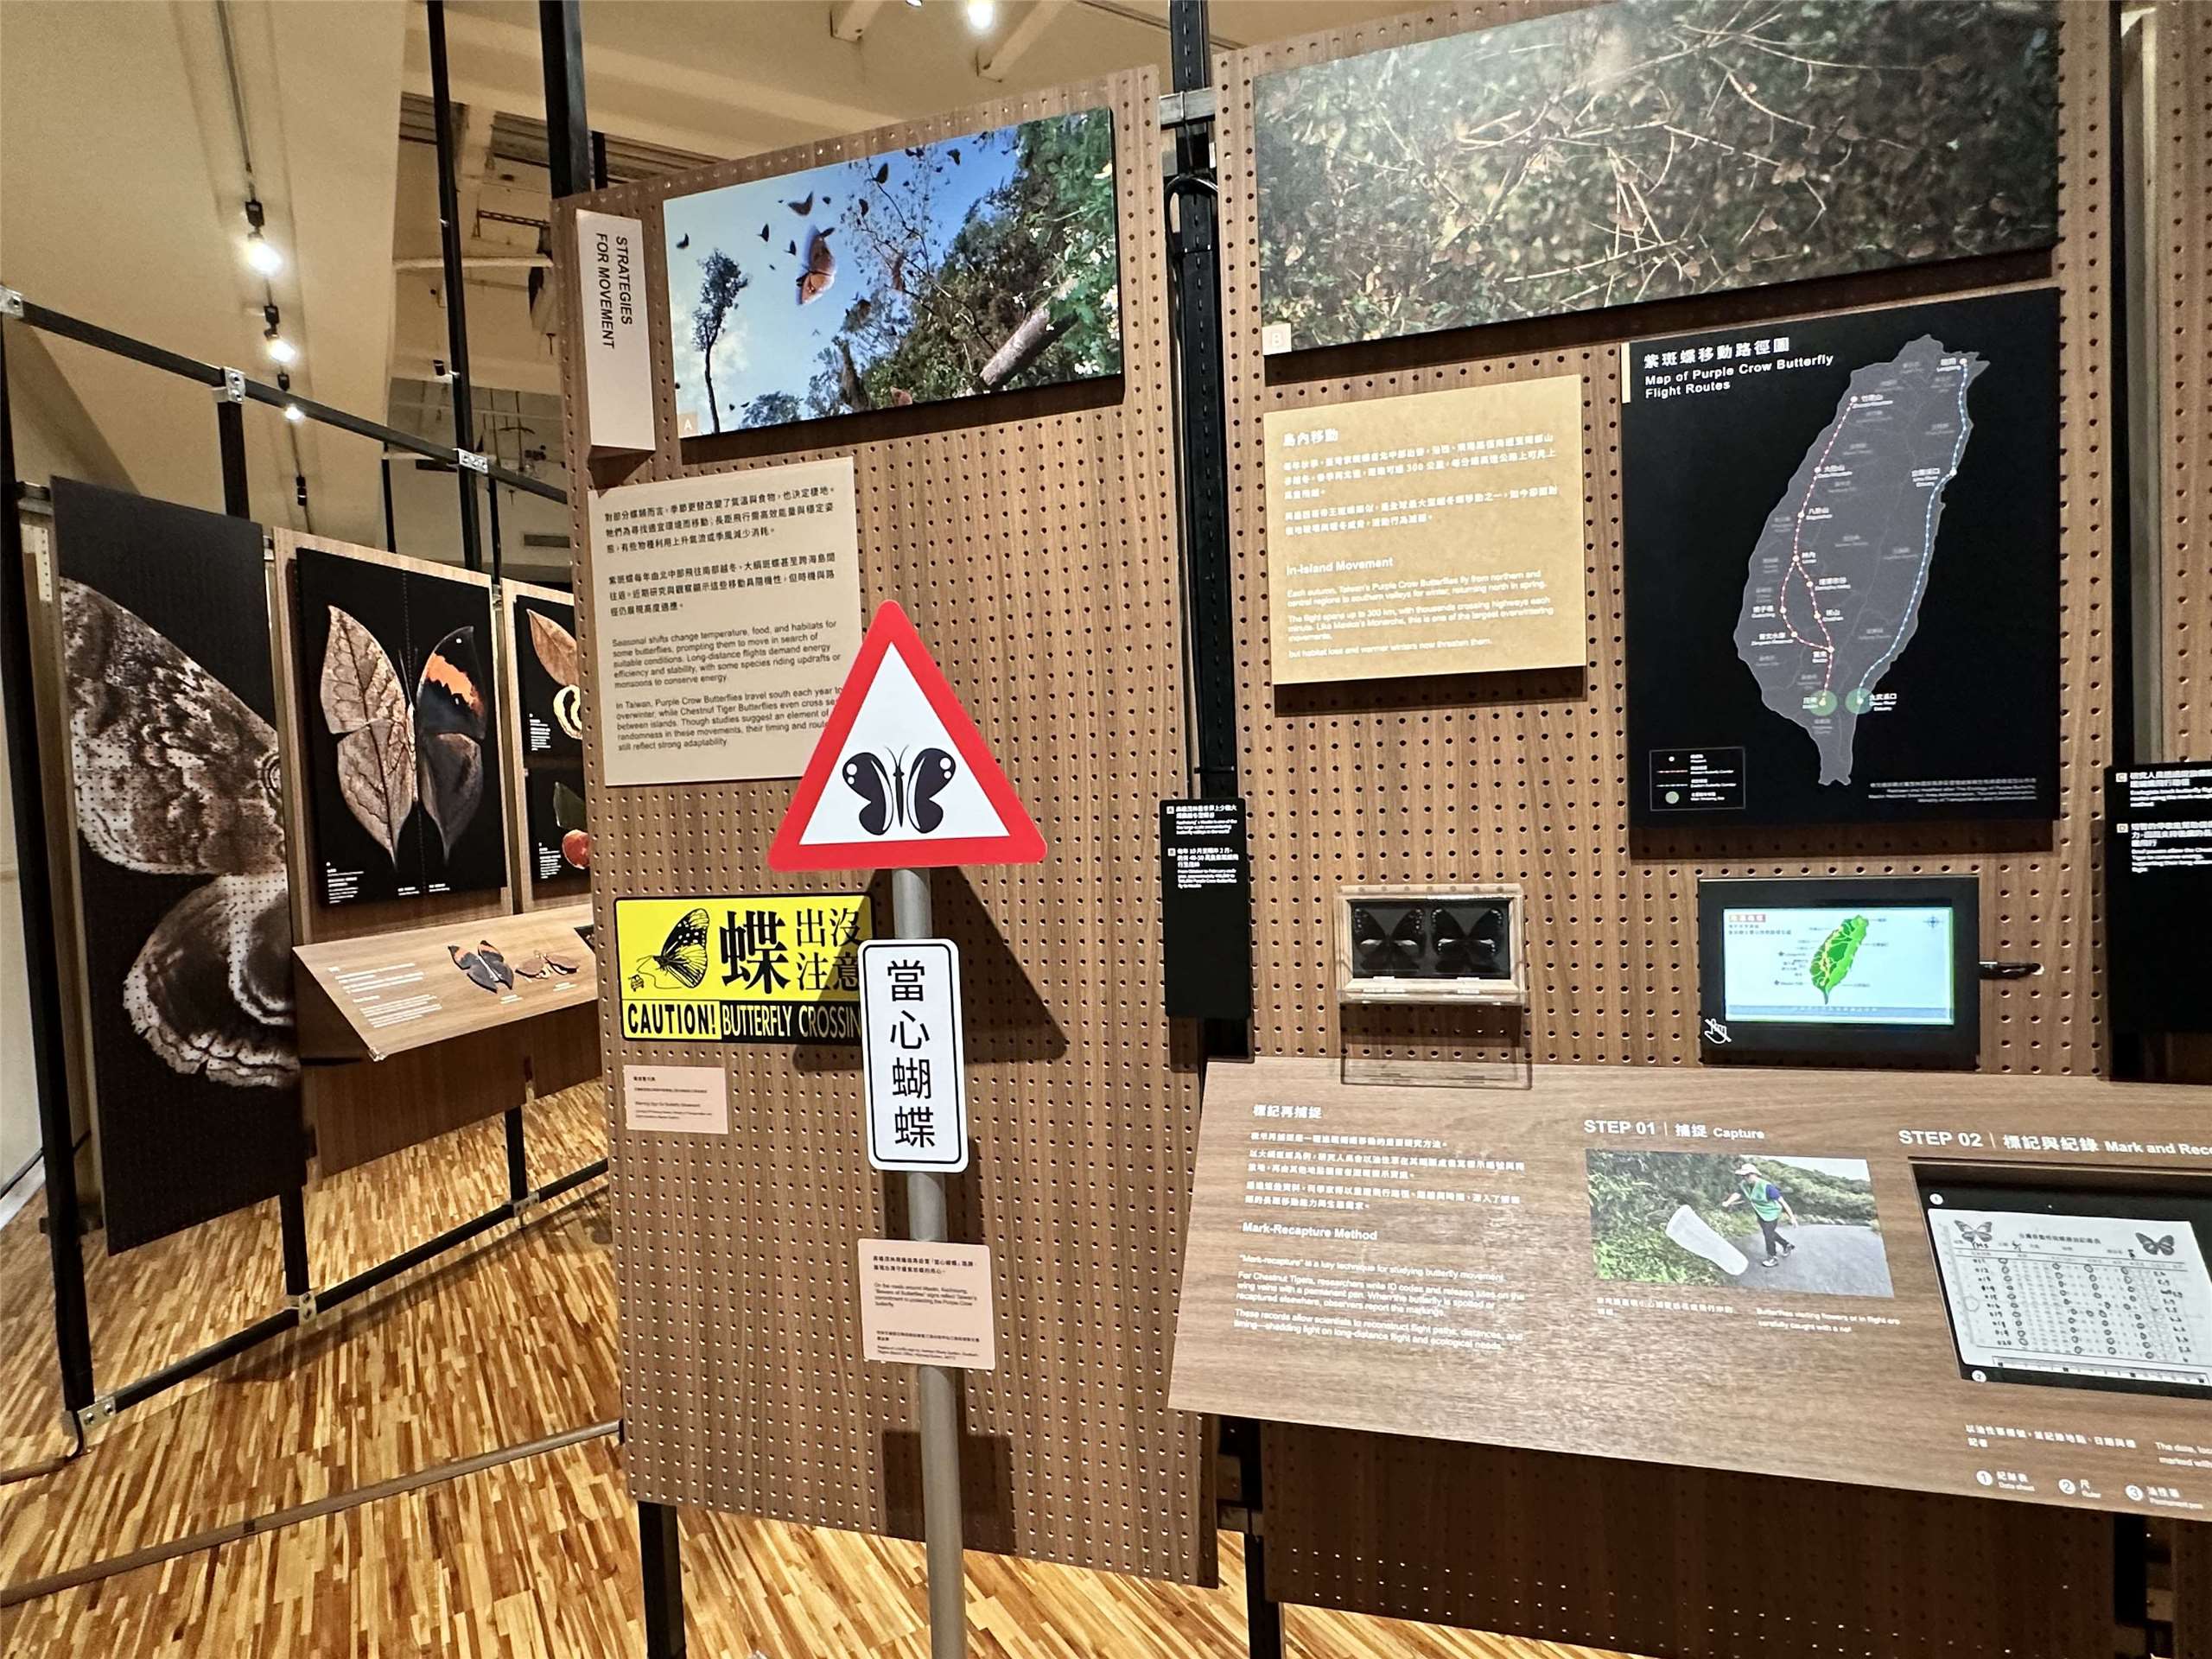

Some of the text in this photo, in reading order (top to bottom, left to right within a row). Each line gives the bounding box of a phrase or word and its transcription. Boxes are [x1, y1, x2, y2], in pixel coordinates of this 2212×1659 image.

[596, 232, 615, 349] FOR MOVEMENT
[615, 235, 632, 325] STRATEGIES
[1643, 337, 1790, 369] 紫斑蝶移動路徑圖
[1645, 354, 1834, 387] Map of Purple Crow Butterfly
[1645, 380, 1731, 399] Flight Routes
[671, 632, 698, 641] change
[774, 624, 789, 632] and
[791, 622, 823, 631] habitats
[676, 641, 715, 653] prompting
[780, 633, 808, 643] search
[686, 651, 741, 662] Long-distance
[742, 648, 766, 658] flights
[768, 645, 800, 655] demand
[803, 645, 830, 653] energy
[613, 668, 648, 677] efficiency
[651, 665, 665, 674] and
[699, 662, 715, 671] with
[741, 658, 771, 670] species
[772, 657, 795, 666] riding
[797, 654, 830, 665] updrafts
[655, 697, 679, 707] Purple
[703, 693, 742, 702] Butterflies
[744, 691, 766, 700] travel
[768, 690, 791, 698] south
[792, 688, 812, 696] each
[815, 689, 832, 697] year
[658, 707, 677, 715] while
[680, 705, 715, 715] Chestnut
[717, 704, 735, 714] Tiger
[738, 702, 778, 711] Butterflies
[682, 716, 709, 726] Though
[712, 715, 739, 723] studies
[741, 713, 772, 723] suggest
[786, 709, 819, 719] element
[617, 731, 663, 740] randomness
[765, 722, 789, 732] timing
[658, 741, 681, 749] strong
[797, 907, 864, 947] 出沒
[720, 910, 791, 995] 蝶
[797, 951, 859, 992] 注意
[627, 1002, 862, 1039] CAUTION! BUTTERFLY CROSSIN
[887, 959, 935, 1149] 當心蝴蝶
[1584, 1120, 1764, 1141] STEP 01 捕捉 Capture
[1899, 1130, 1952, 1146] STEP
[1958, 1132, 1984, 1147] 02
[2105, 1141, 2143, 1153] Mark
[2146, 1143, 2176, 1154] and
[1243, 1222, 1377, 1239] Mark-Recapture Method
